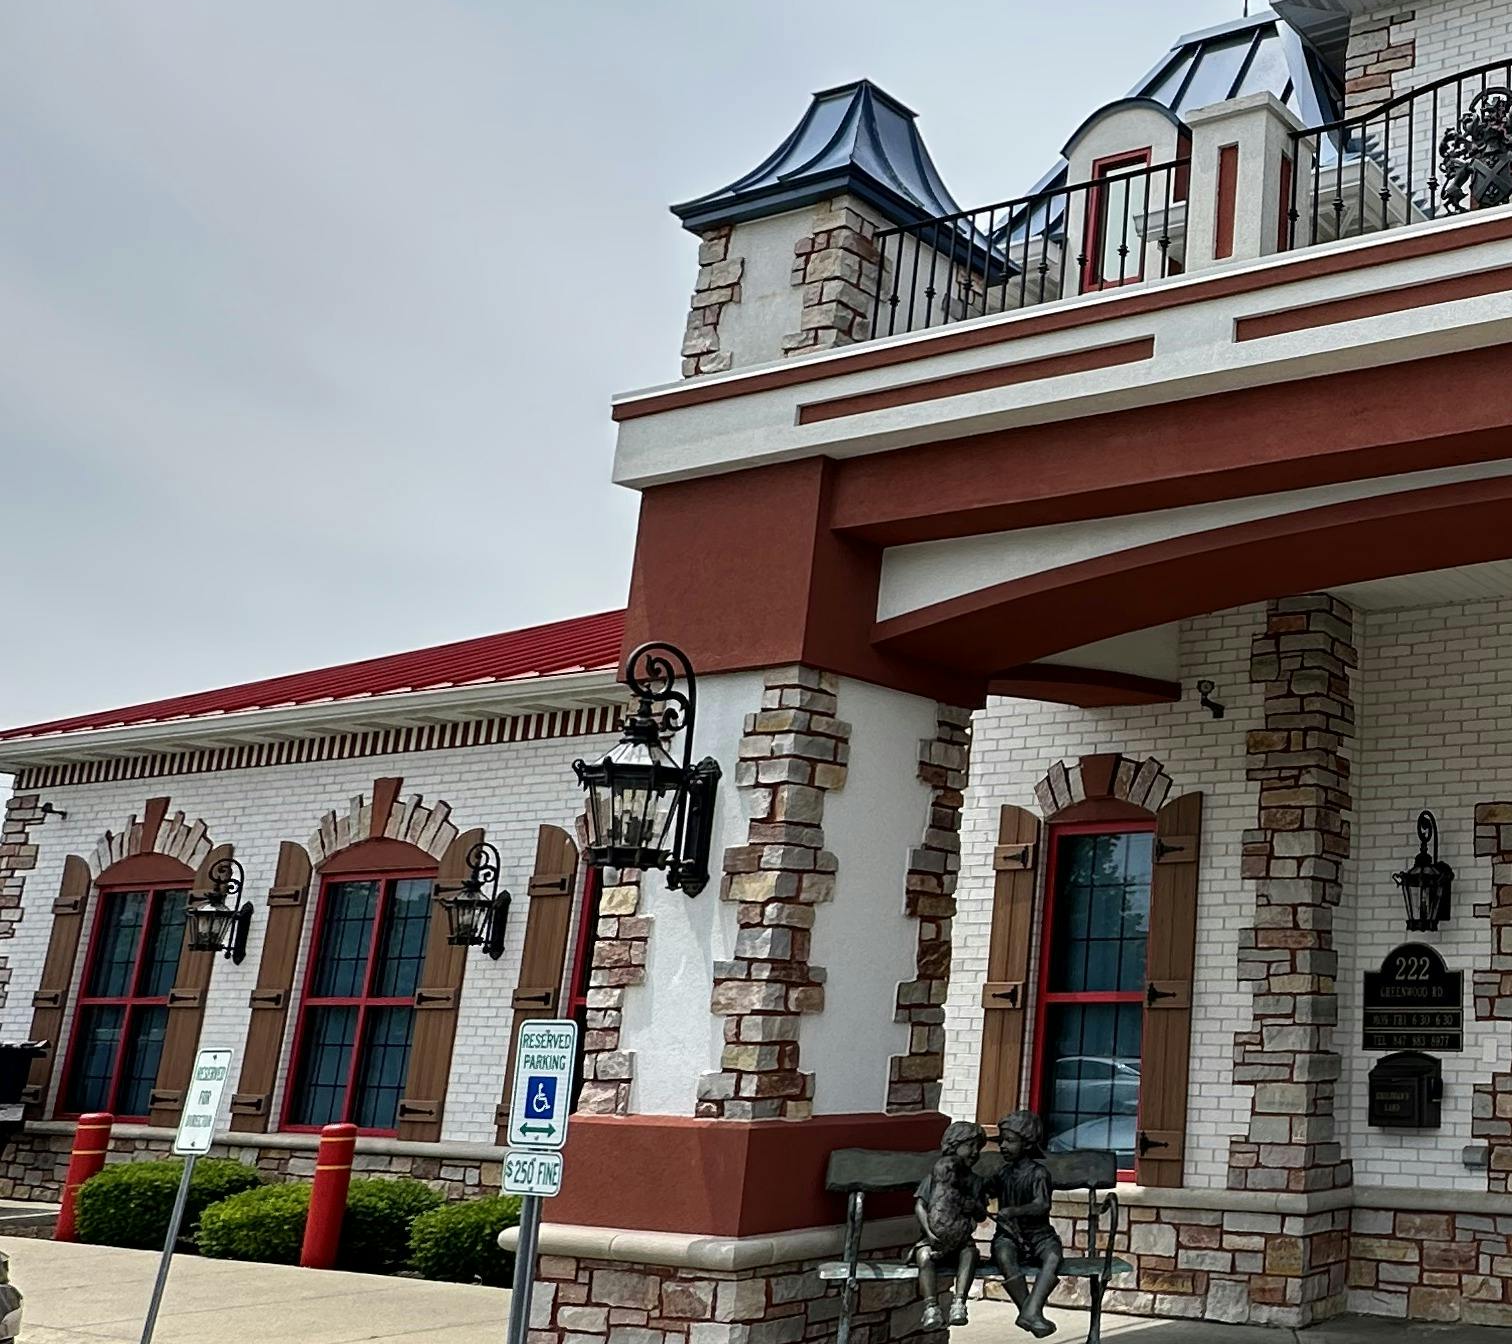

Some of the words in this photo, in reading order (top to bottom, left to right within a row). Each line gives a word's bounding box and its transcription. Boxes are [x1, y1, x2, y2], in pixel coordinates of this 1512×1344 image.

[1395, 956, 1430, 980] 222
[522, 1033, 571, 1049] RESERVED
[523, 1054, 566, 1070] PARKING
[505, 1159, 535, 1184] $250
[537, 1162, 560, 1186] FINE
